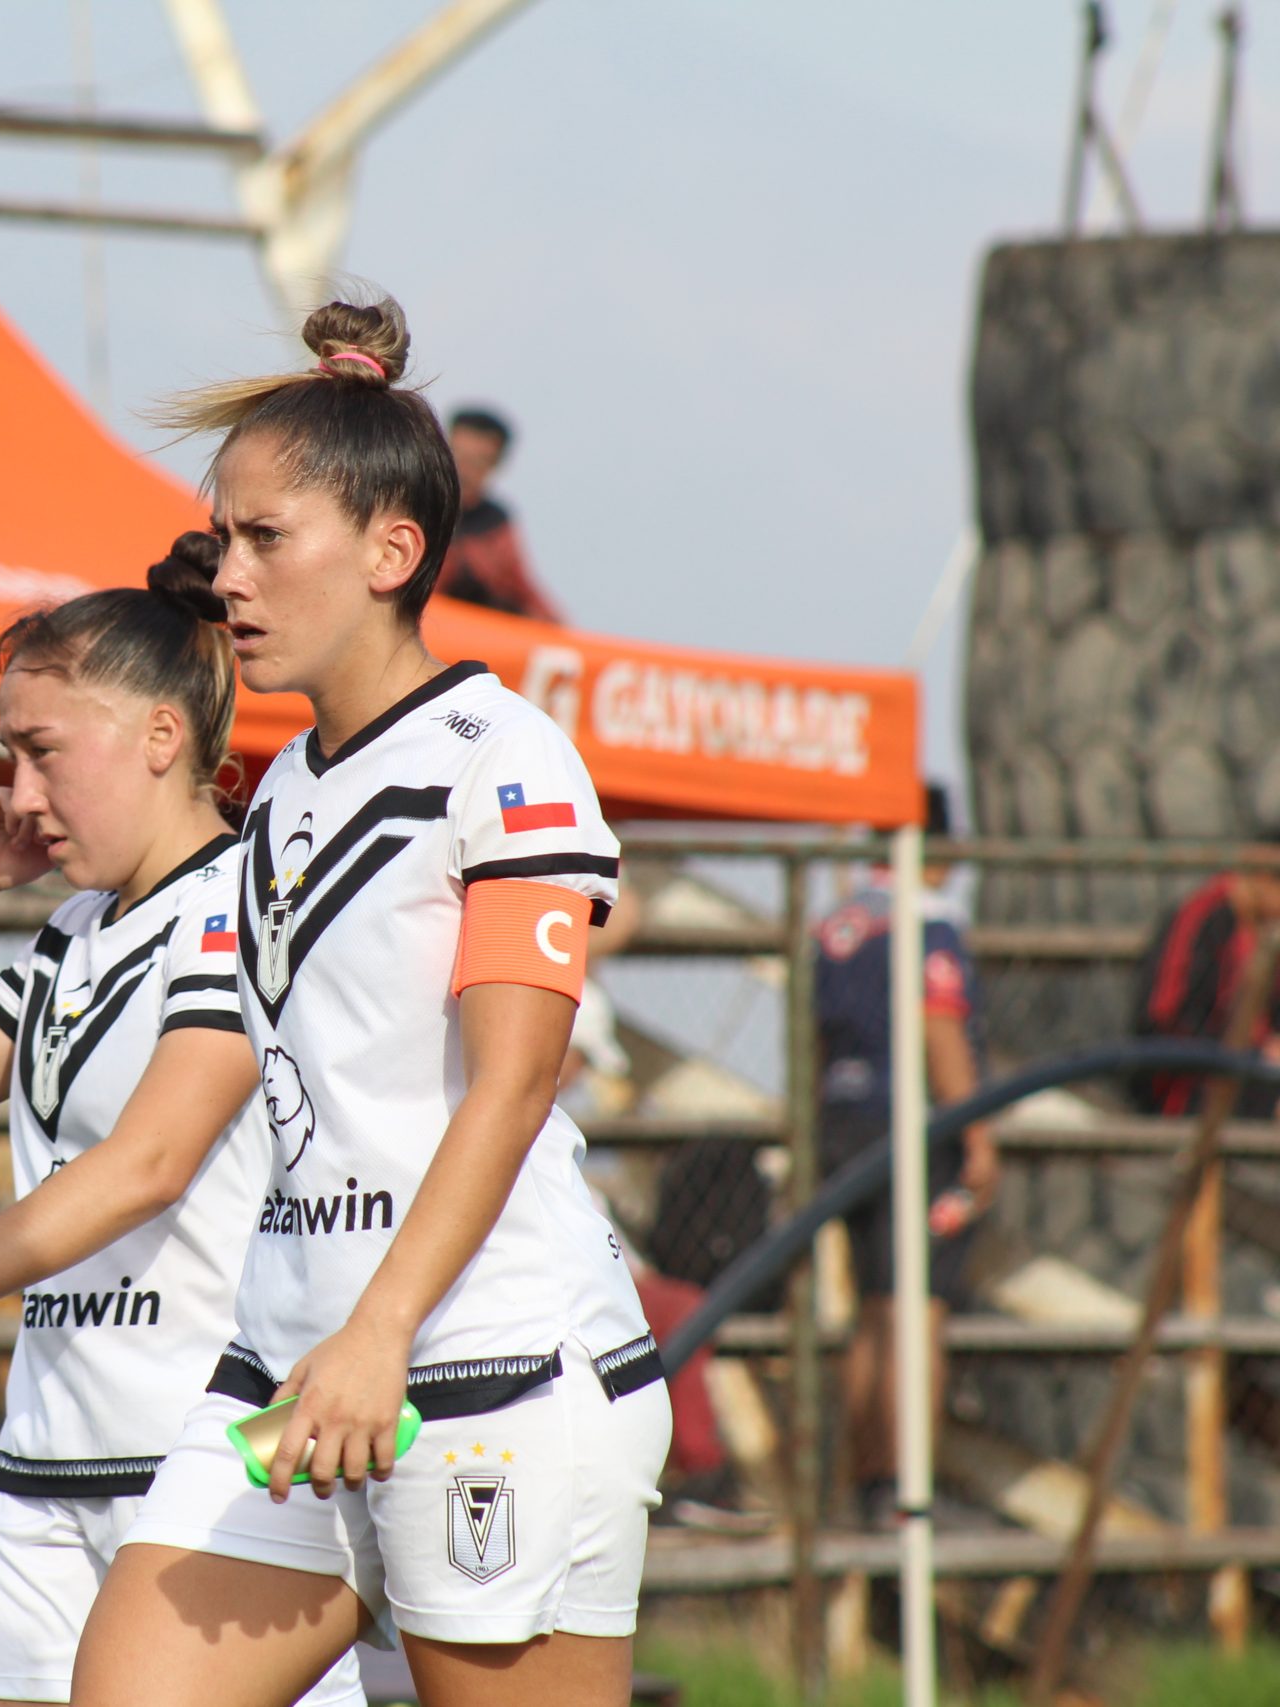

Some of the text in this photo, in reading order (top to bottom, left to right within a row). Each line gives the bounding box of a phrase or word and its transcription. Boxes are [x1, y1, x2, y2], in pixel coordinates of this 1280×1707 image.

[593, 661, 868, 775] GATORADE
[535, 910, 573, 965] C
[22, 1276, 161, 1328] amwin
